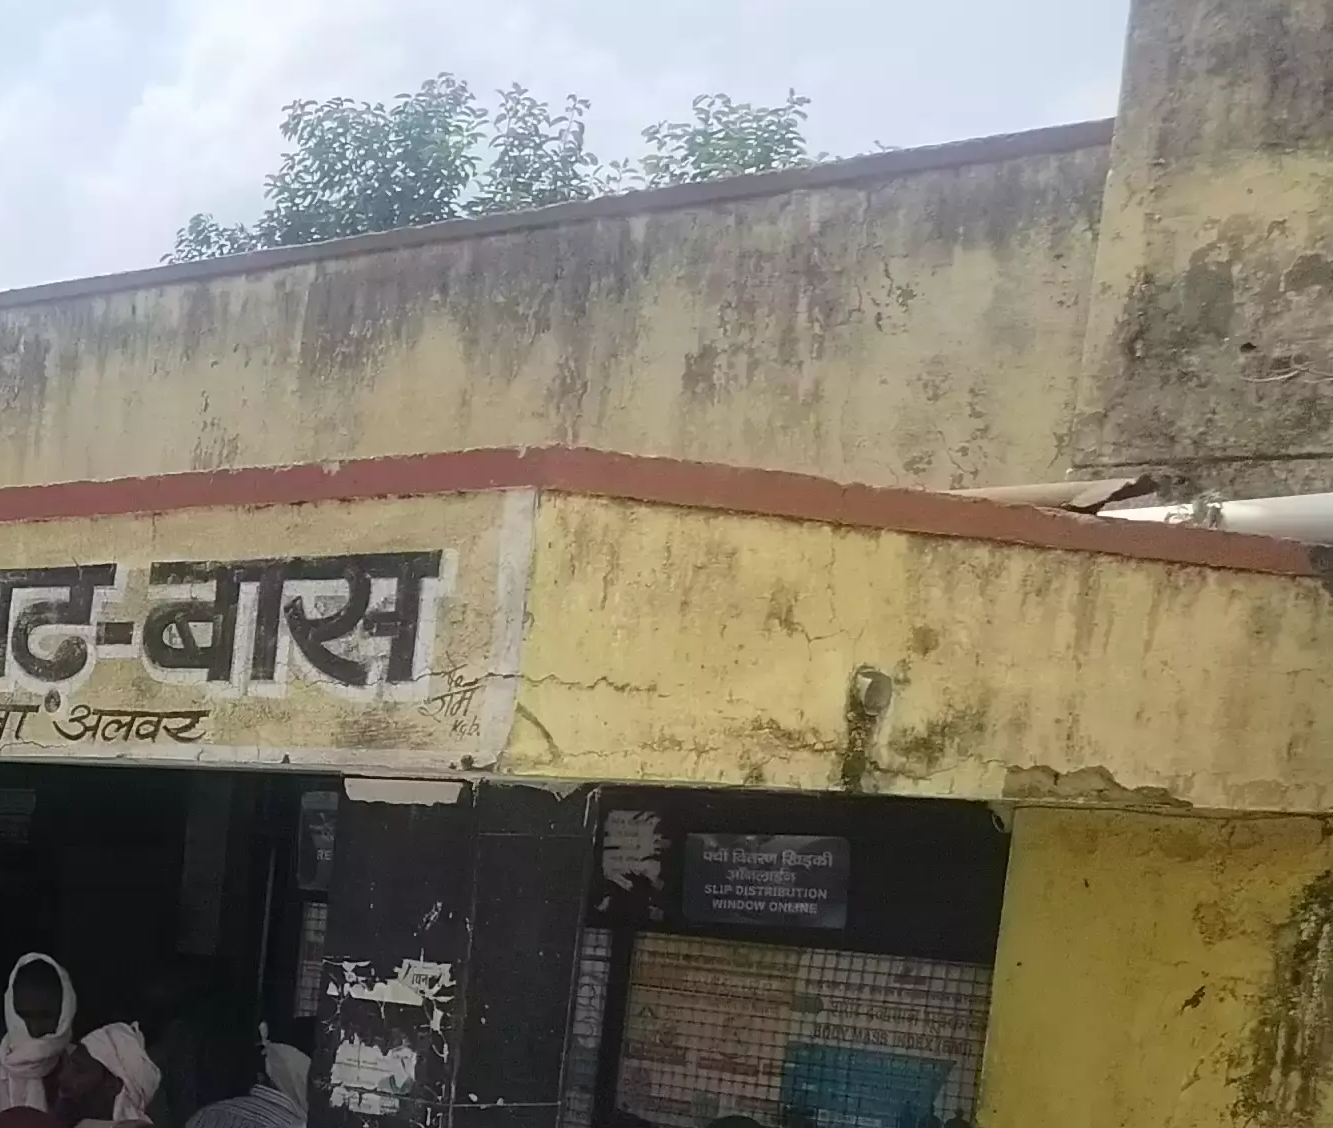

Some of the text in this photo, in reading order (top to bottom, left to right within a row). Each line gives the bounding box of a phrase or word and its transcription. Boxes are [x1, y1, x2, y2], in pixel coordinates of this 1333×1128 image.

[54, 705, 209, 743] अलवर
[705, 885, 828, 900] SLIP DISTRIBUTION
[712, 898, 818, 915] WINDOW ONLINE
